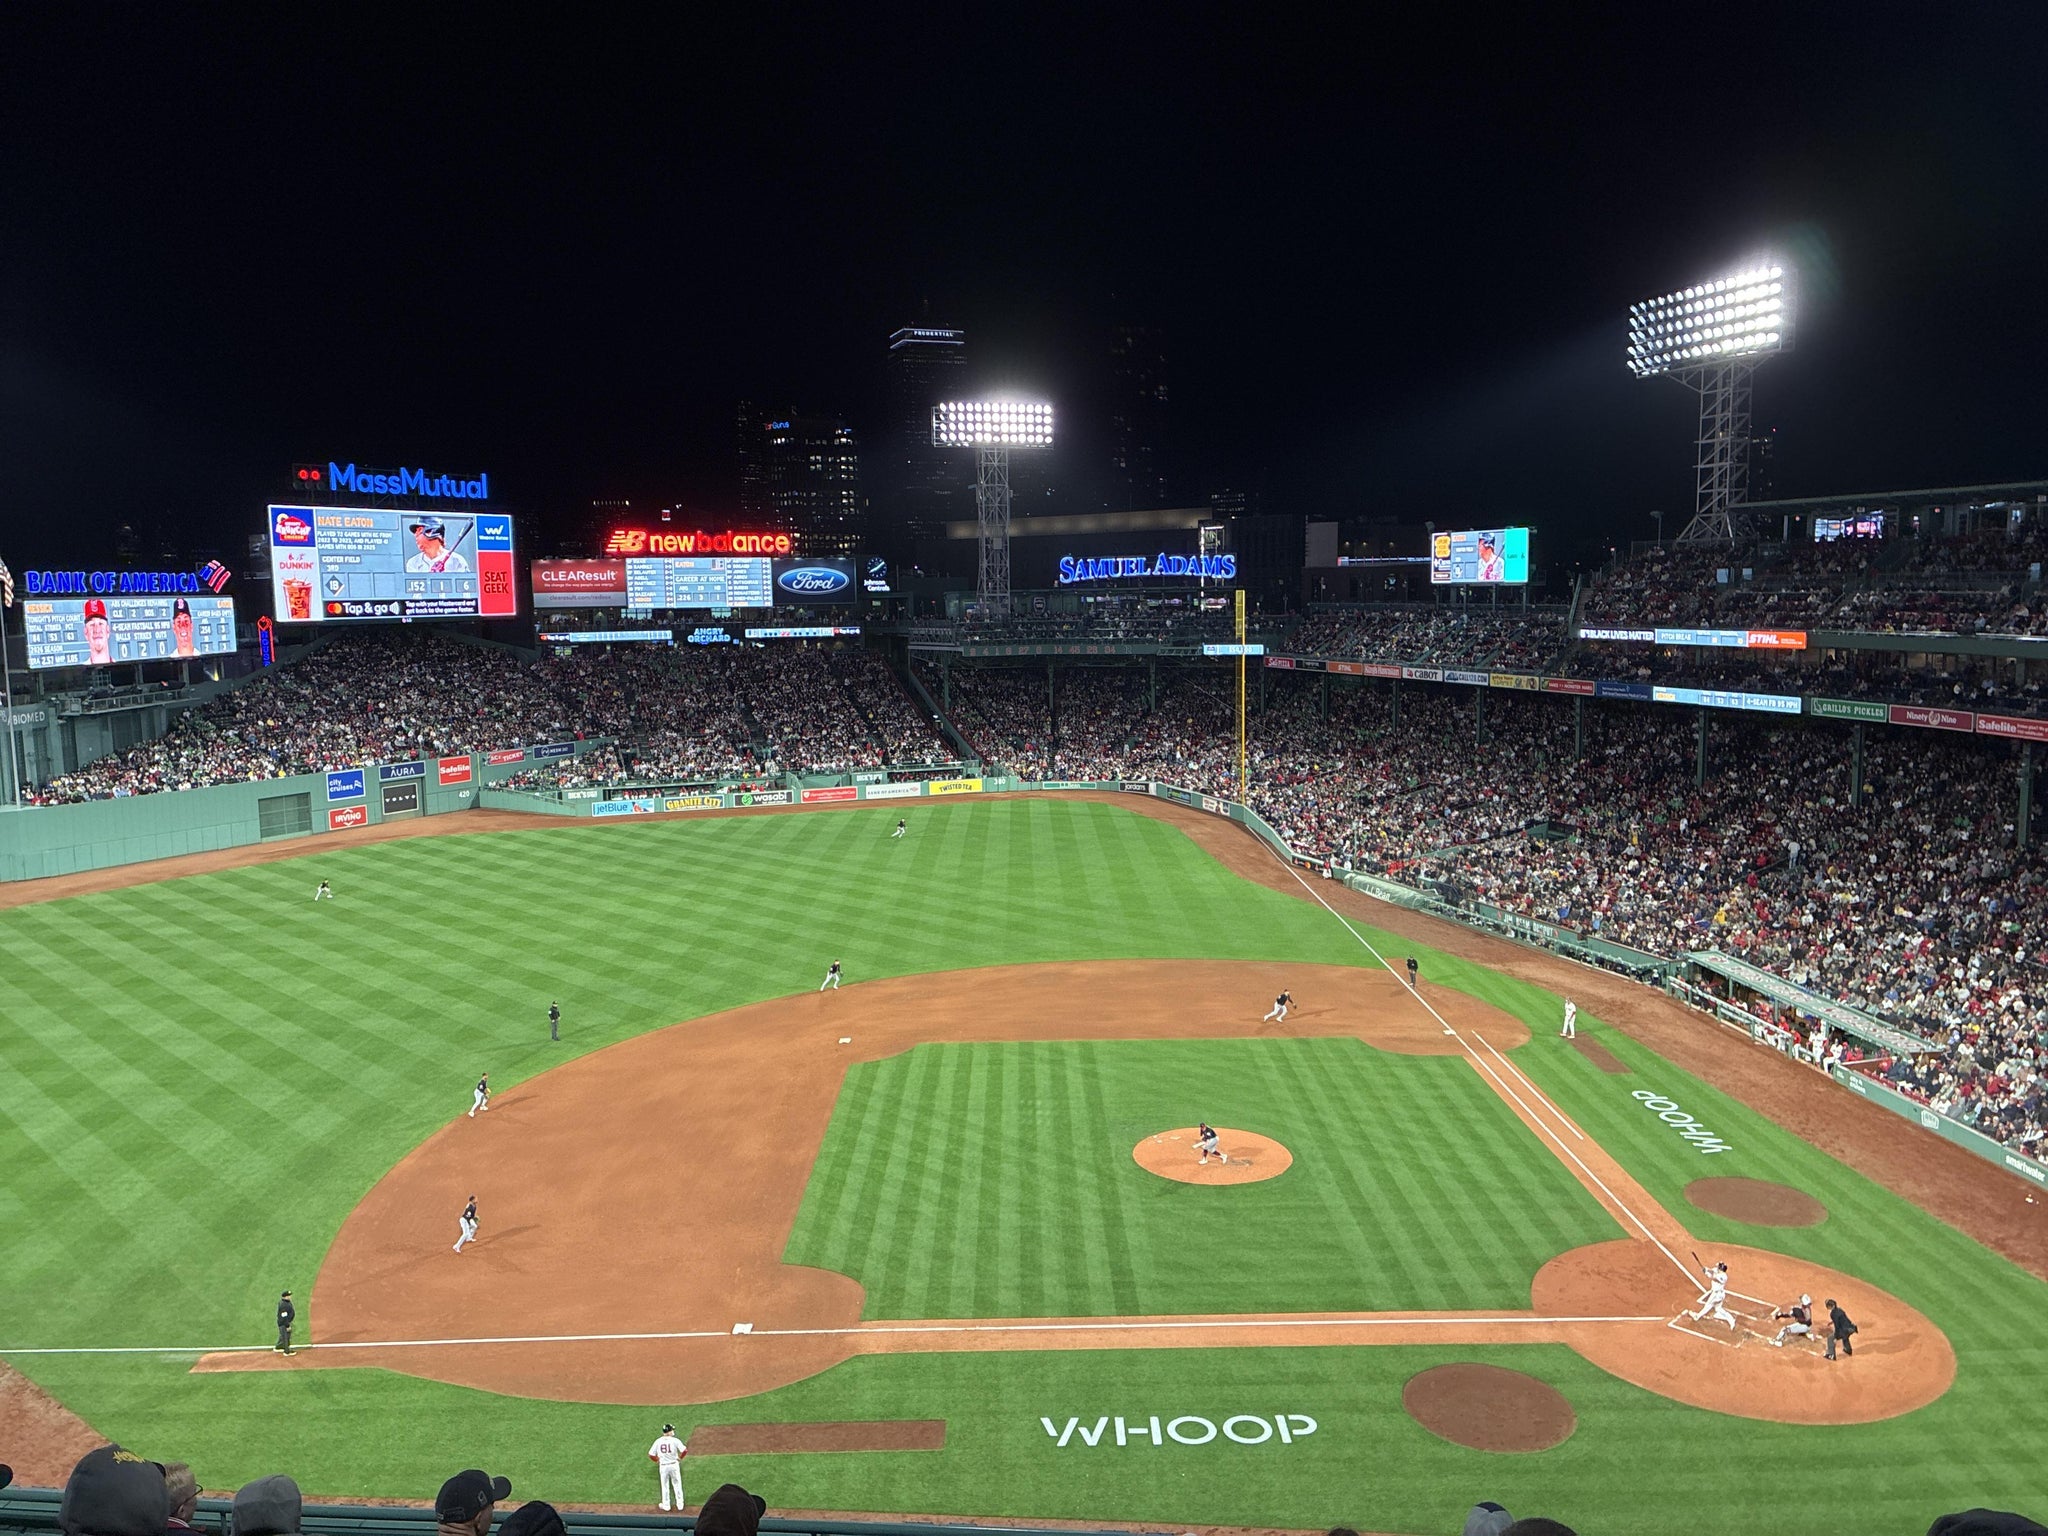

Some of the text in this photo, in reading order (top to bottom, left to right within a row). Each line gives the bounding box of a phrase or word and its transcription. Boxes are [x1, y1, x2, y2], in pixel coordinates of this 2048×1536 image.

[329, 461, 488, 499] MassMutual
[317, 516, 374, 528] NATE EATON
[279, 562, 314, 570] DUNKIN'
[1060, 552, 1237, 584] SAMUEL ADAMS
[484, 571, 507, 583] SEAT
[541, 570, 616, 581] CLEAResult
[792, 571, 834, 590] Ford
[26, 570, 200, 594] BANK OF AMERICA
[329, 580, 339, 591] 1B
[408, 581, 425, 592] .152
[463, 581, 470, 590] 6
[483, 583, 509, 594] GEEK
[131, 609, 137, 617] 2
[161, 609, 167, 617] 2
[343, 602, 388, 616] Tap & go
[27, 616, 51, 624] TONIGHT'S
[51, 615, 65, 623] PITCH
[28, 624, 43, 632] TOTAL
[131, 622, 154, 630] FASTBALL
[694, 627, 724, 636] ANGRY
[115, 633, 131, 641] BALLS
[134, 632, 152, 640] STRIKES
[687, 634, 731, 643] ORCHARD
[1590, 630, 1655, 641] BLACK LIVES MATTER
[1661, 632, 1674, 640] PITCH
[1749, 634, 1780, 645] STIHL
[121, 641, 166, 657] 0 2 0
[41, 656, 54, 665] 2.57
[1338, 664, 1352, 672] STIHL
[1746, 699, 1769, 707] 4-SEAM
[1777, 699, 1785, 708] 95
[1785, 700, 1798, 709] MPH
[1822, 705, 1884, 717] GRILLO'S PICKLES
[1906, 711, 1957, 723] Ninety Nine
[1979, 720, 2017, 733] Safelite
[502, 751, 523, 761] TICKET
[440, 765, 470, 774] Safelite
[329, 779, 342, 787] city
[329, 784, 353, 792] cruises
[939, 783, 972, 792] TWISTED TEA
[459, 790, 470, 798] 420
[568, 791, 587, 799] DICK'S
[753, 791, 787, 802] wasabi
[596, 803, 628, 814] jetBlue
[666, 796, 723, 811] GRANITE CITY
[335, 812, 362, 823] IRVING
[1503, 913, 1513, 923] JIM
[1515, 916, 1531, 929] BEAM
[1631, 1090, 1733, 1154] WHOOP
[2005, 1154, 2047, 1183] smartwater
[1040, 1414, 1318, 1447] WHOOP
[660, 1443, 672, 1454] 81
